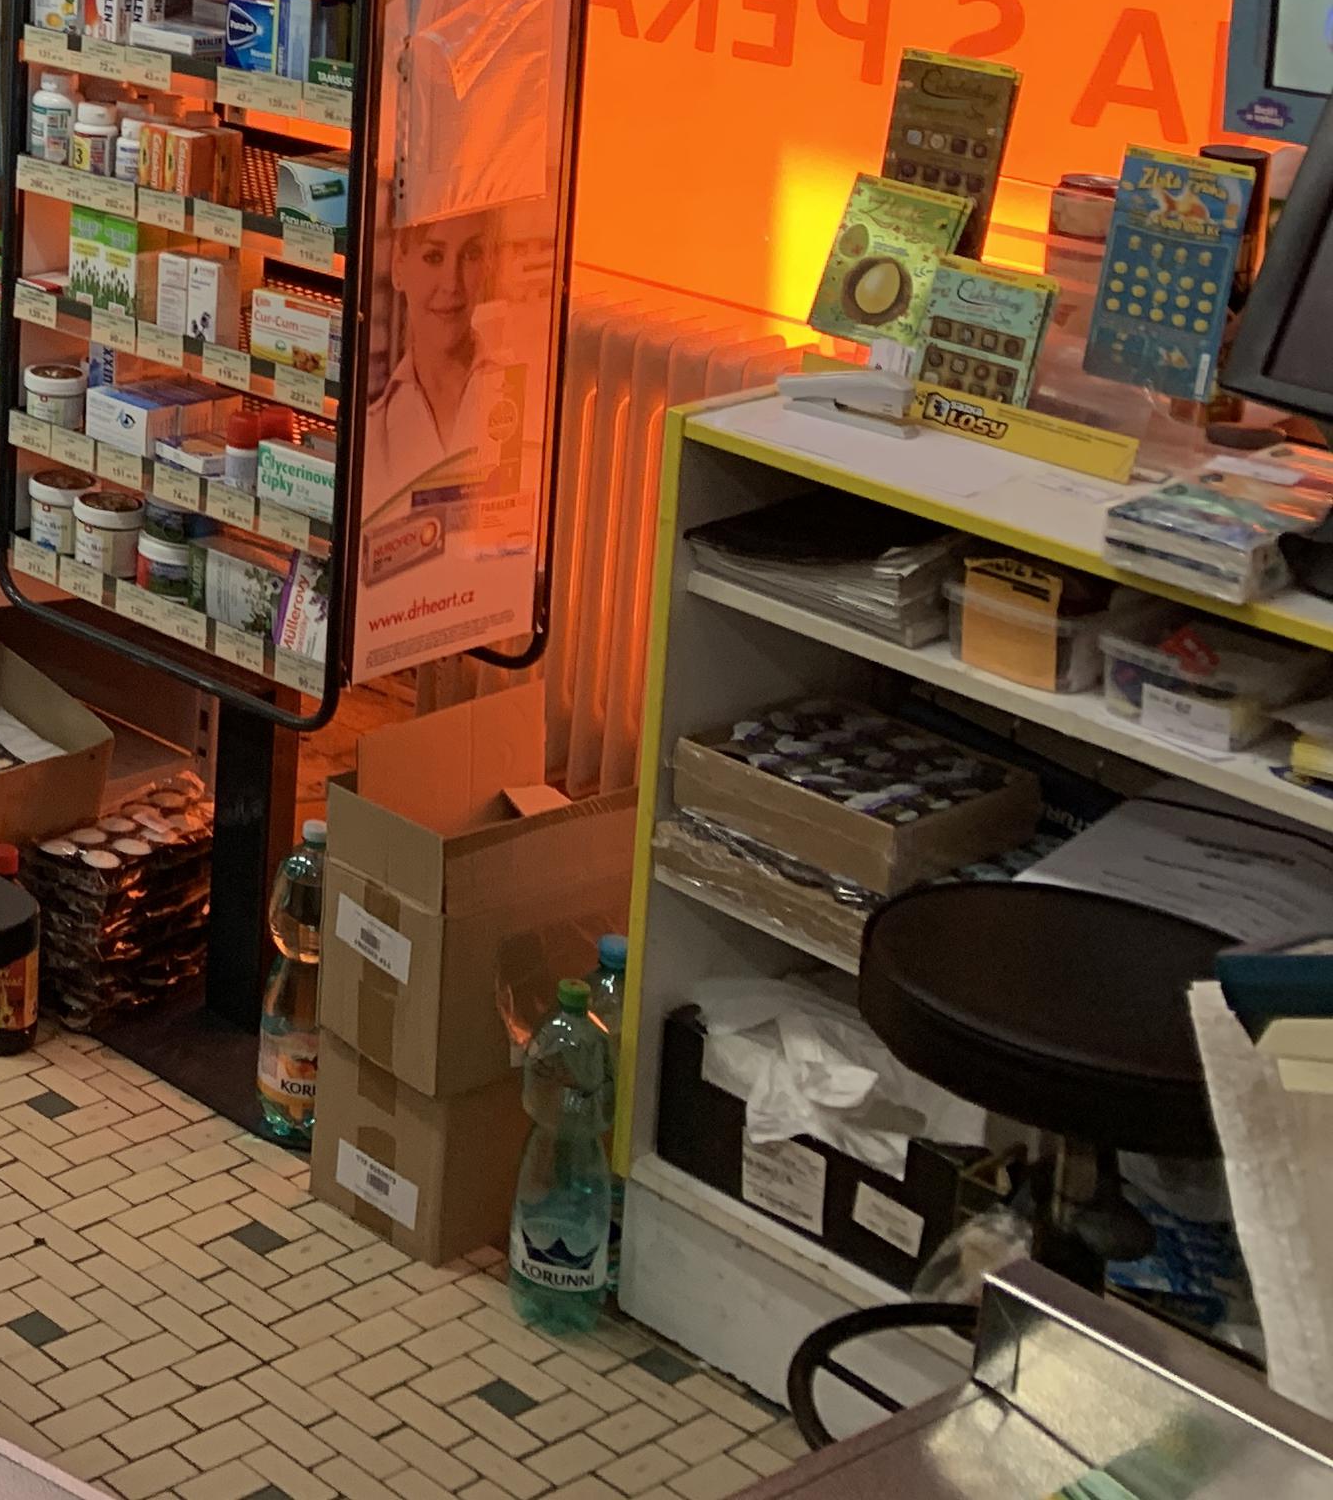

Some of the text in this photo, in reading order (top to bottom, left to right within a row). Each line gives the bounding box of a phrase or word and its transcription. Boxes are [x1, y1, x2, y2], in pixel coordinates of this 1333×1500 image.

[253, 307, 299, 332] Cur-Cum
[948, 413, 1009, 439] LOSY
[368, 590, 475, 632] www.drheart.cz
